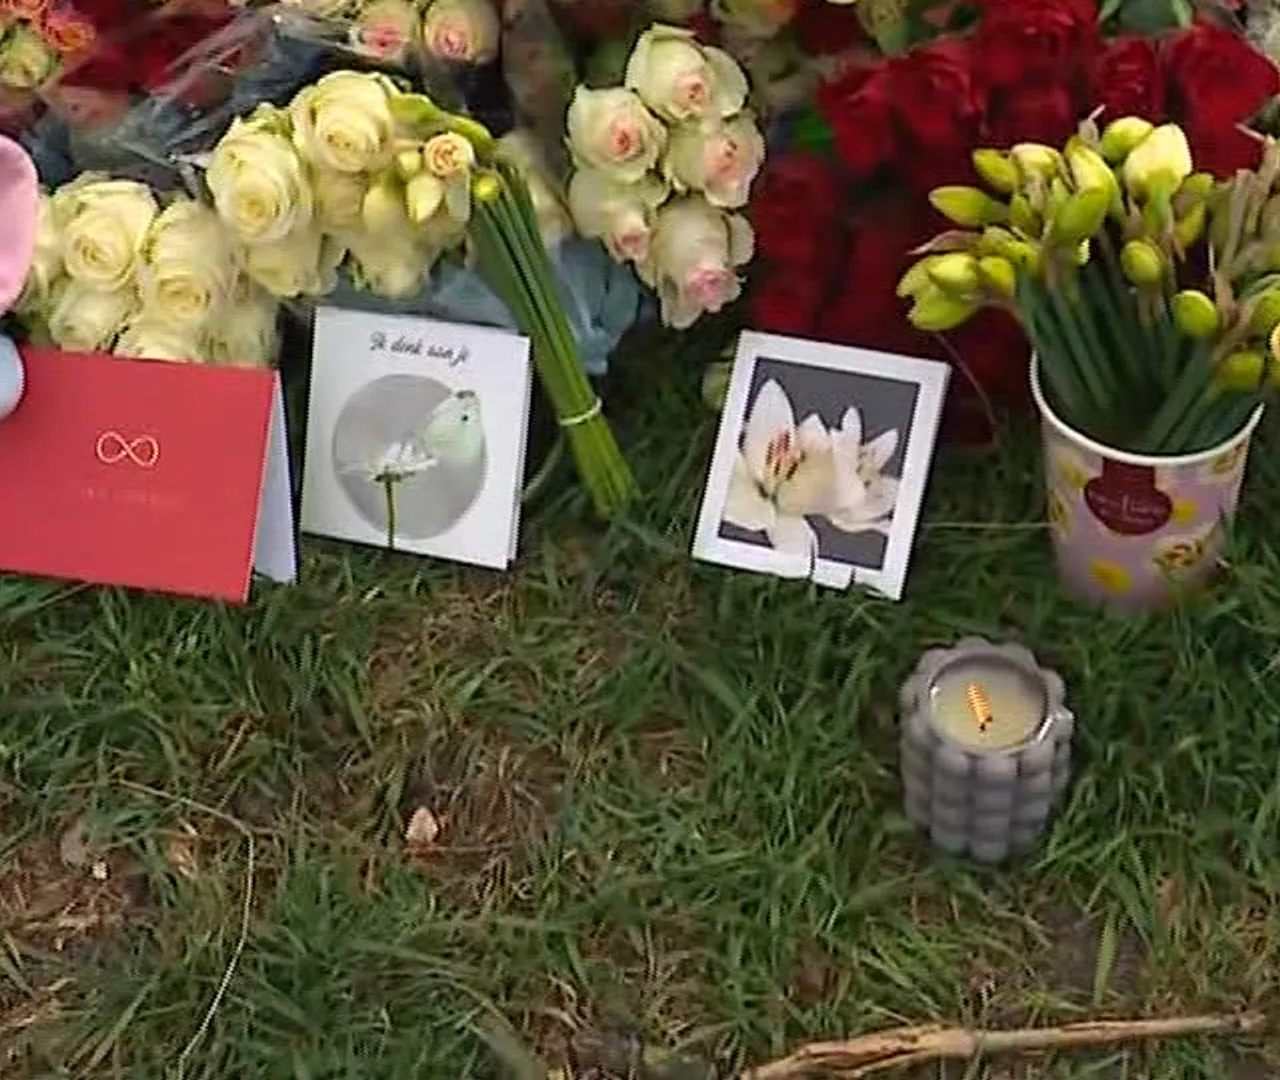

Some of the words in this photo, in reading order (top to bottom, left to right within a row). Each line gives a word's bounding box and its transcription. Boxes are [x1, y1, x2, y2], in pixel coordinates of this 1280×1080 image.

[390, 336, 423, 355] denk
[427, 344, 453, 359] aan
[449, 344, 470, 367] je
